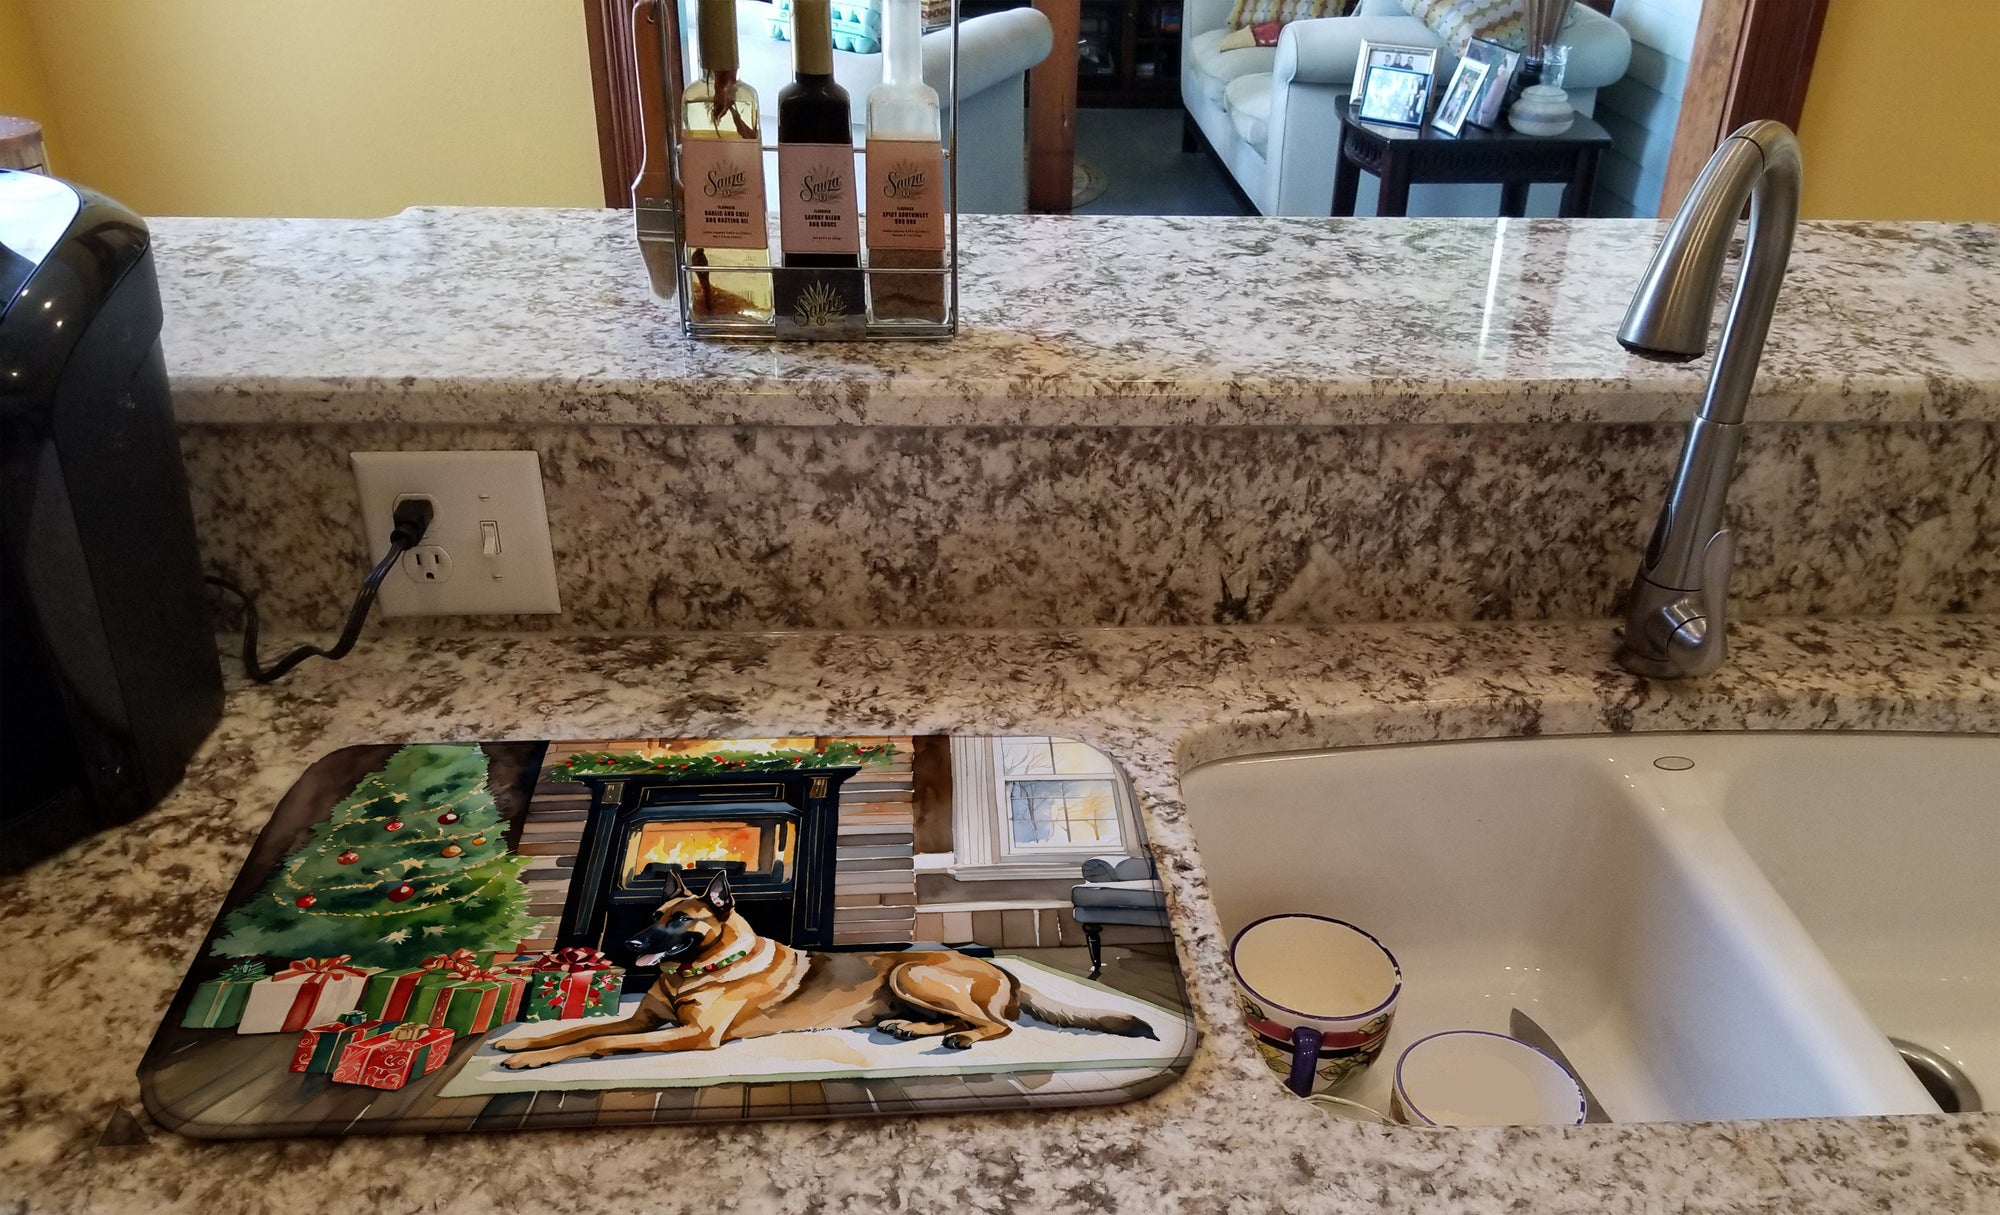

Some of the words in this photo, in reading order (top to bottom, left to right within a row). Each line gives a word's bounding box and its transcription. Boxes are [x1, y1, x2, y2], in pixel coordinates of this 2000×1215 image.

[703, 169, 745, 197] Sauza
[800, 175, 841, 202] Sauza
[883, 170, 924, 198] Sauza
